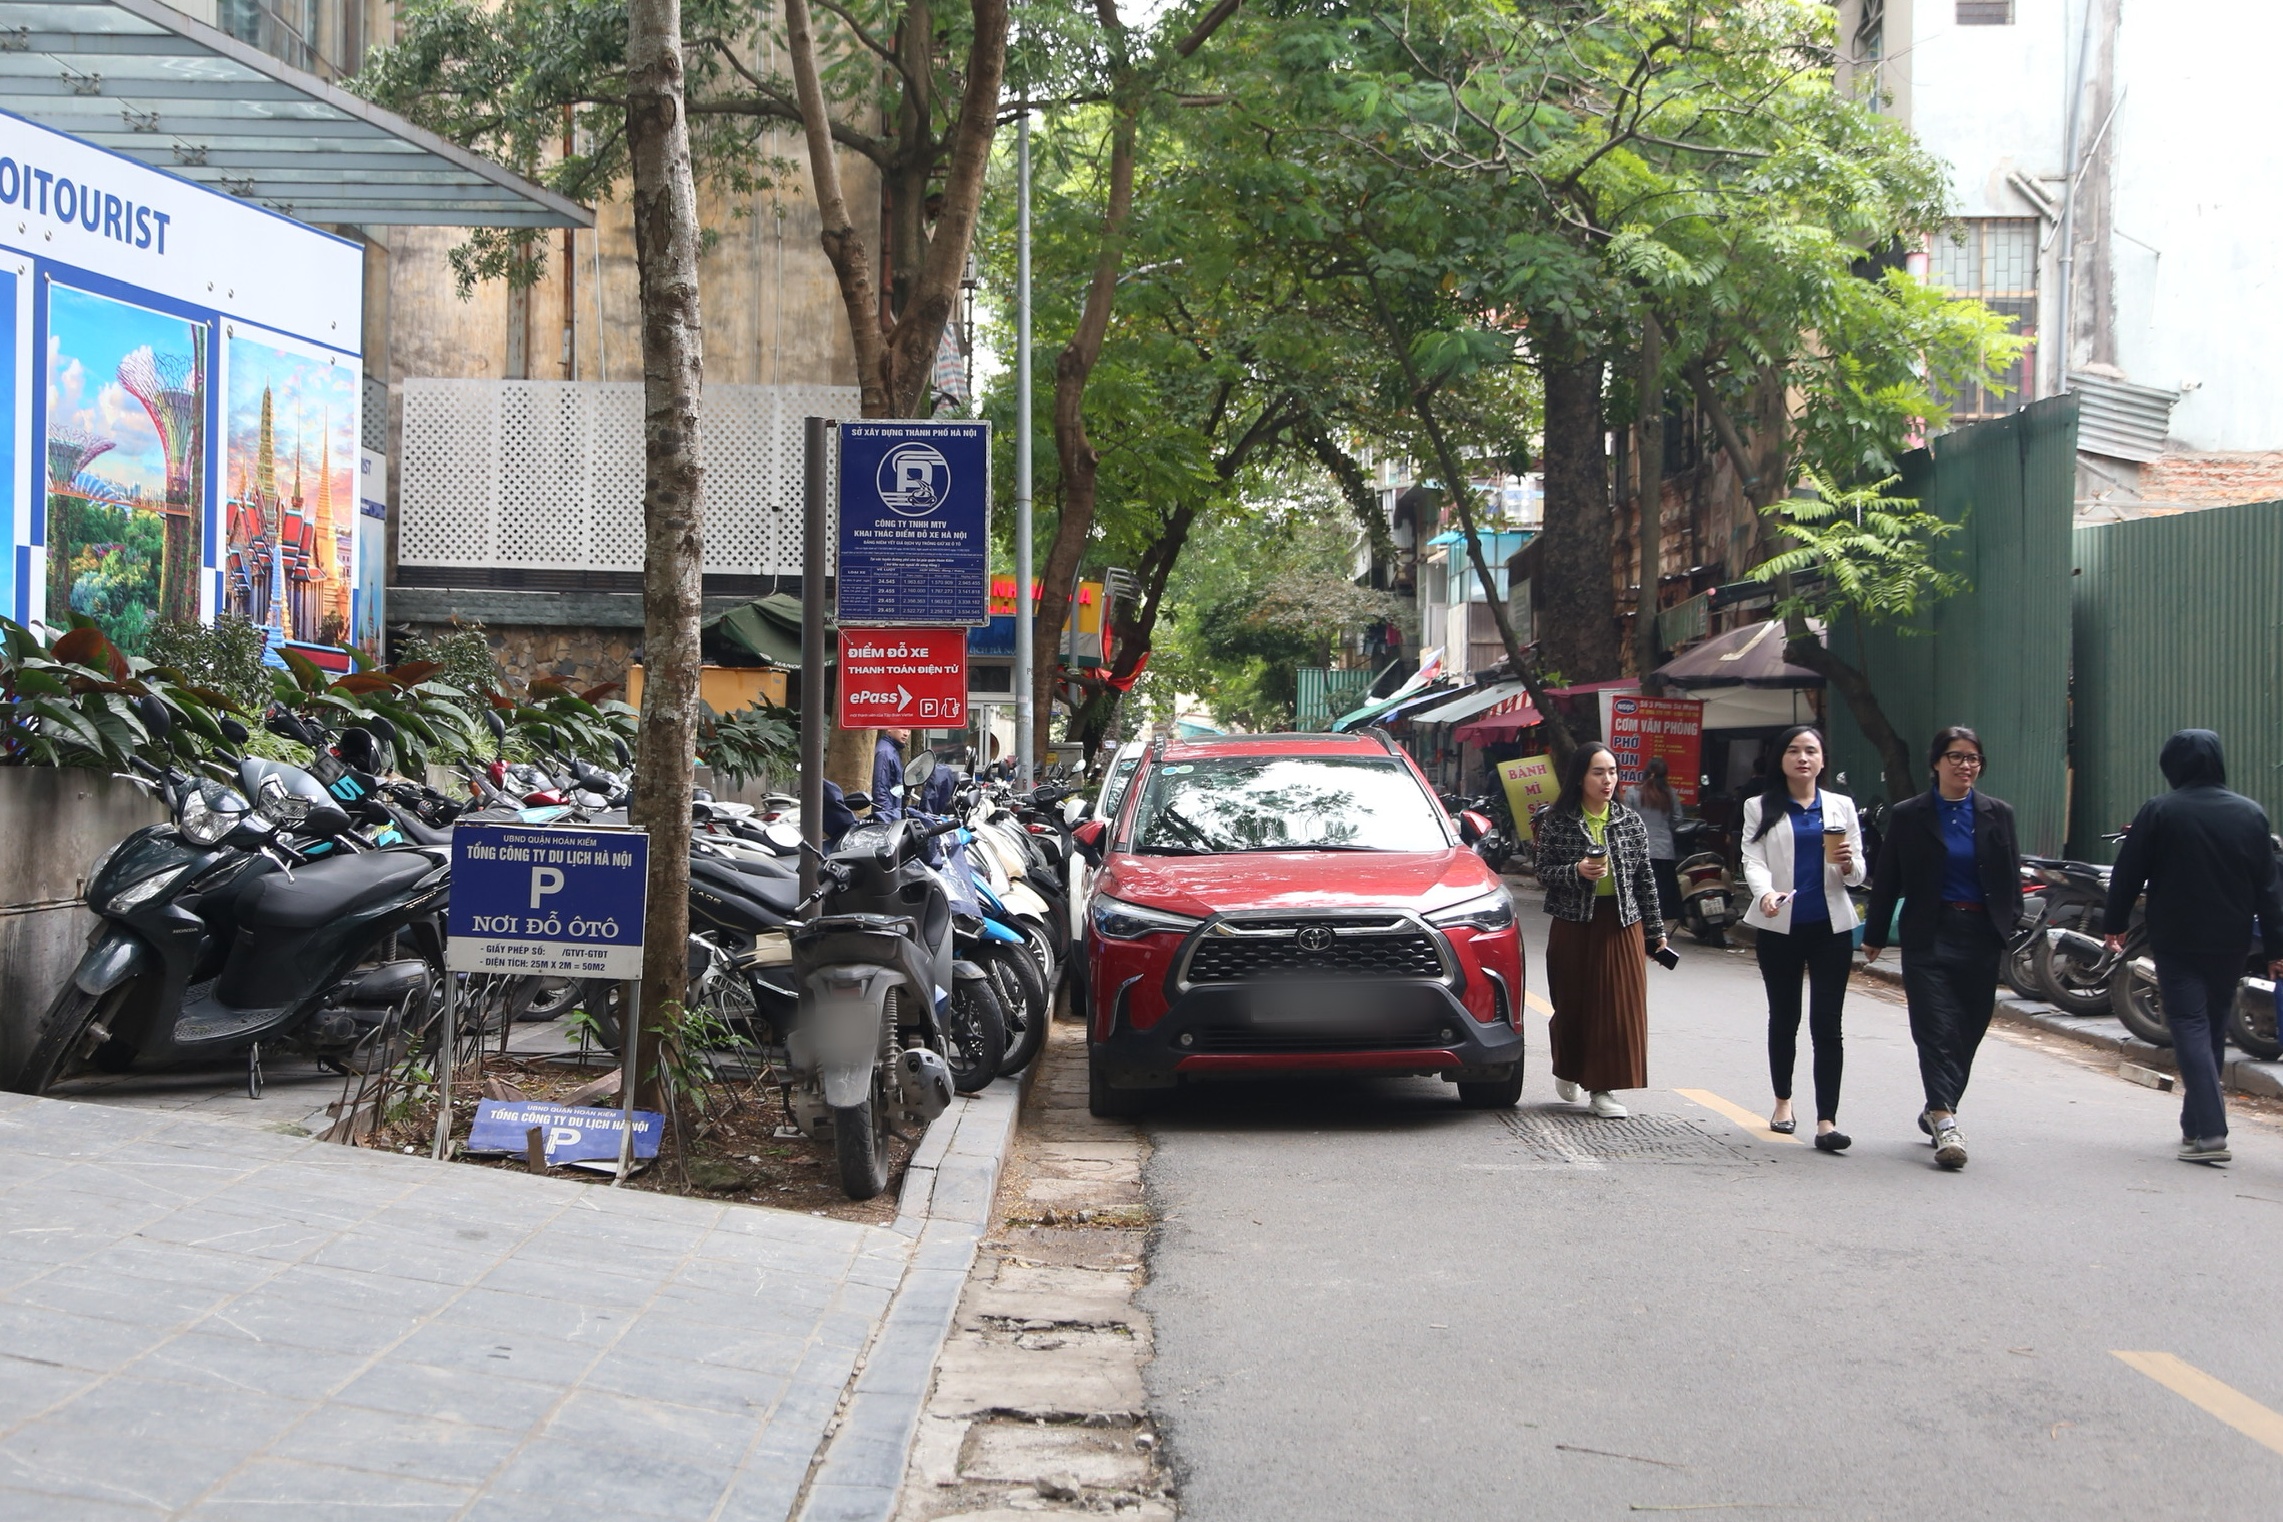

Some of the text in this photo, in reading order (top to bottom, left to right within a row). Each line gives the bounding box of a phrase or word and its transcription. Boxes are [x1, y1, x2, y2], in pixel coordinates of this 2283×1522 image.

[852, 426, 977, 438] SỞ XÂY DỰNG THÀNH PHỐ HÀ NỘI
[875, 519, 947, 528] CÔNG TY TNHH MTV
[874, 530, 893, 538] THÁC
[941, 530, 951, 538] HÀ
[954, 531, 967, 540] NỘI
[848, 642, 929, 658] ĐIỂM ĐỖ XE
[886, 664, 916, 674] TOÁN
[917, 664, 943, 675] ĐIỆN
[944, 664, 959, 674] TỬ
[850, 691, 898, 703] ePass
[1615, 717, 1638, 732] CƠM
[1641, 718, 1661, 733] VĂN
[503, 835, 526, 843] UBND
[527, 836, 551, 845] QUẬN
[552, 836, 576, 846] HOÀN
[467, 841, 632, 870] TỔNG CÔNG TY DU LỊCH HÀ NỘI
[530, 866, 565, 909] P
[472, 911, 619, 938] NƠI ĐỖ ÔTÔ
[486, 942, 505, 954] GIẤY
[508, 945, 529, 956] PHÉP
[531, 945, 546, 956] SỐ:
[485, 958, 505, 968] DIỆN
[507, 959, 528, 968] TÍCH:
[530, 960, 548, 968] 25M
[551, 961, 556, 969] X
[558, 961, 572, 970] 2M
[582, 962, 606, 971] 50M2
[550, 1106, 573, 1114] QUẬN
[574, 1108, 596, 1116] HOÀN
[490, 1108, 518, 1122] TỔNG
[521, 1112, 550, 1125] CÔNG
[554, 1116, 565, 1126] TY
[568, 1117, 583, 1127] DU
[585, 1118, 610, 1130] LỊCH
[631, 1120, 649, 1133] NỘI
[545, 1127, 582, 1154] P
